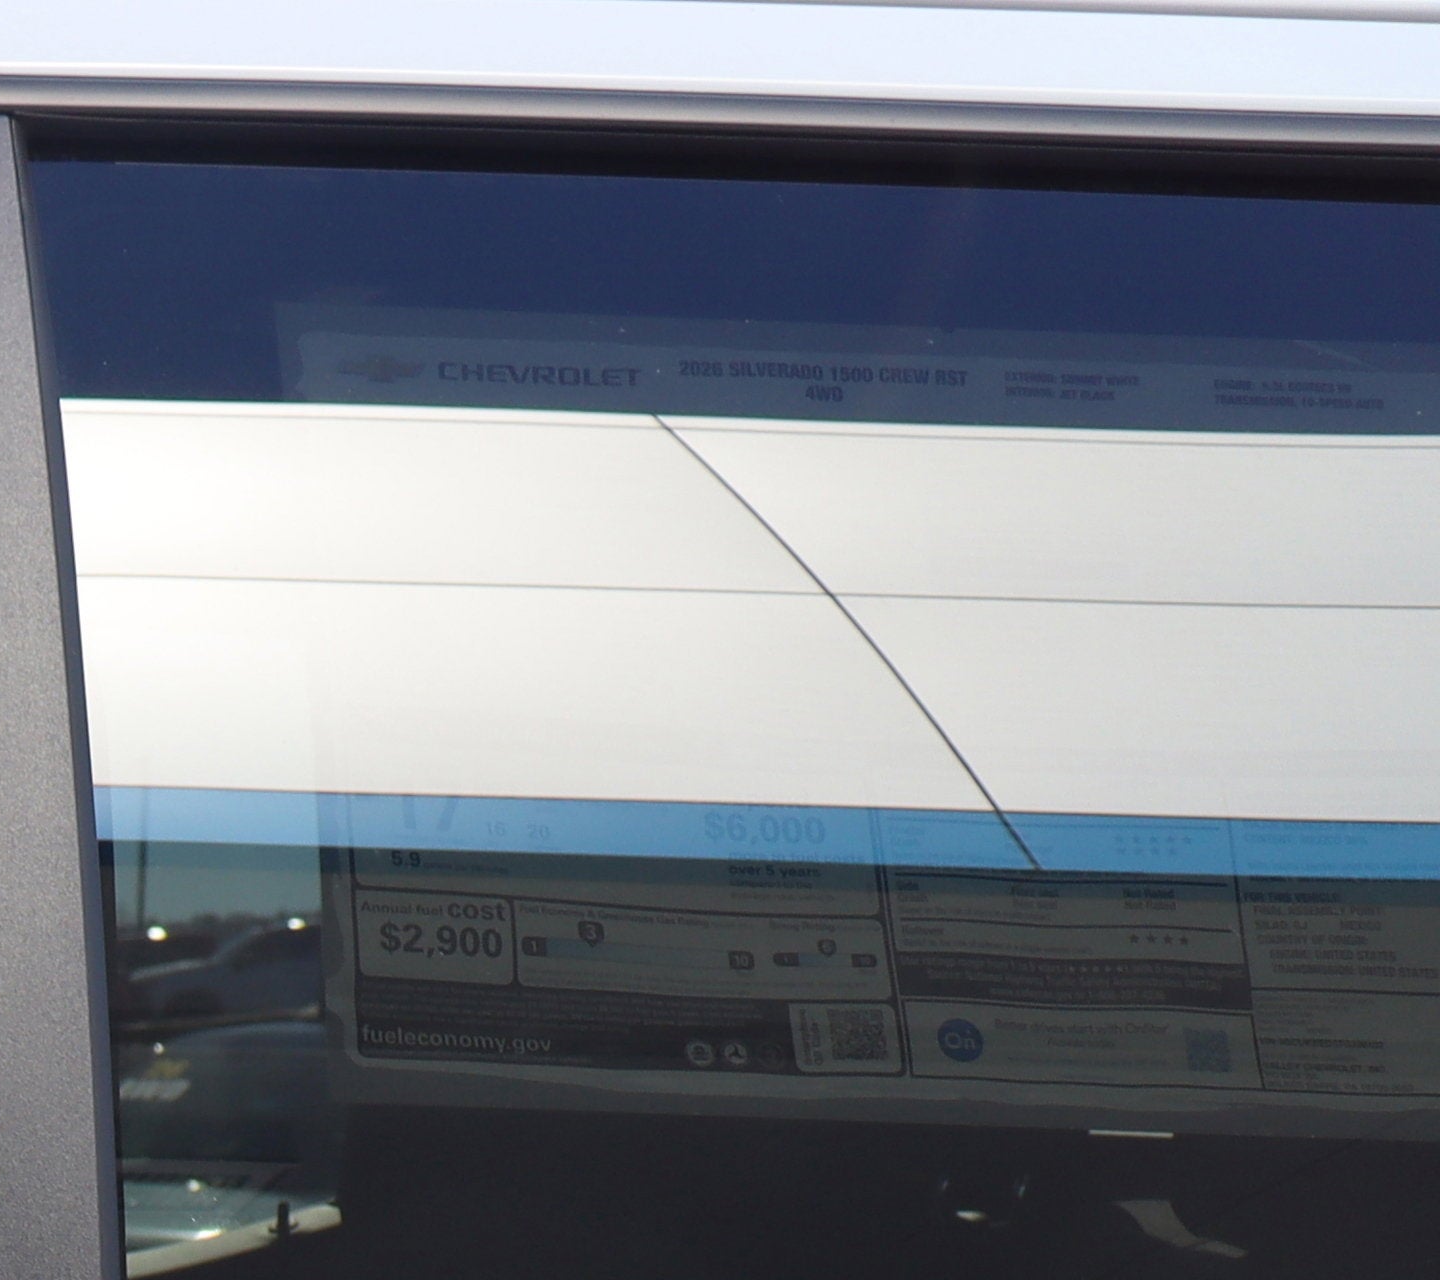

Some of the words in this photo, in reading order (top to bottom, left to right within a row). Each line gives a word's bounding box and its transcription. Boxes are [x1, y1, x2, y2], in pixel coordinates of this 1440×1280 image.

[438, 362, 642, 387] CHEVROLET
[679, 360, 723, 377] 2026
[729, 362, 824, 382] SILVERADO
[829, 366, 874, 383] 1500
[879, 368, 930, 385] CREW
[934, 370, 969, 386] RST
[805, 385, 844, 403] 4WD
[704, 809, 826, 845] $6,000
[391, 851, 421, 868] 5.9
[728, 865, 761, 876] over
[766, 864, 775, 875] 5
[779, 866, 821, 878] years
[361, 900, 413, 915] Annual
[416, 902, 443, 917] fuel
[447, 901, 508, 923] cost
[379, 921, 503, 959] $2,900
[585, 924, 598, 940] 3
[733, 953, 750, 968] 10
[362, 1023, 552, 1054] fueleconomy.gov
[944, 1027, 977, 1050] On
